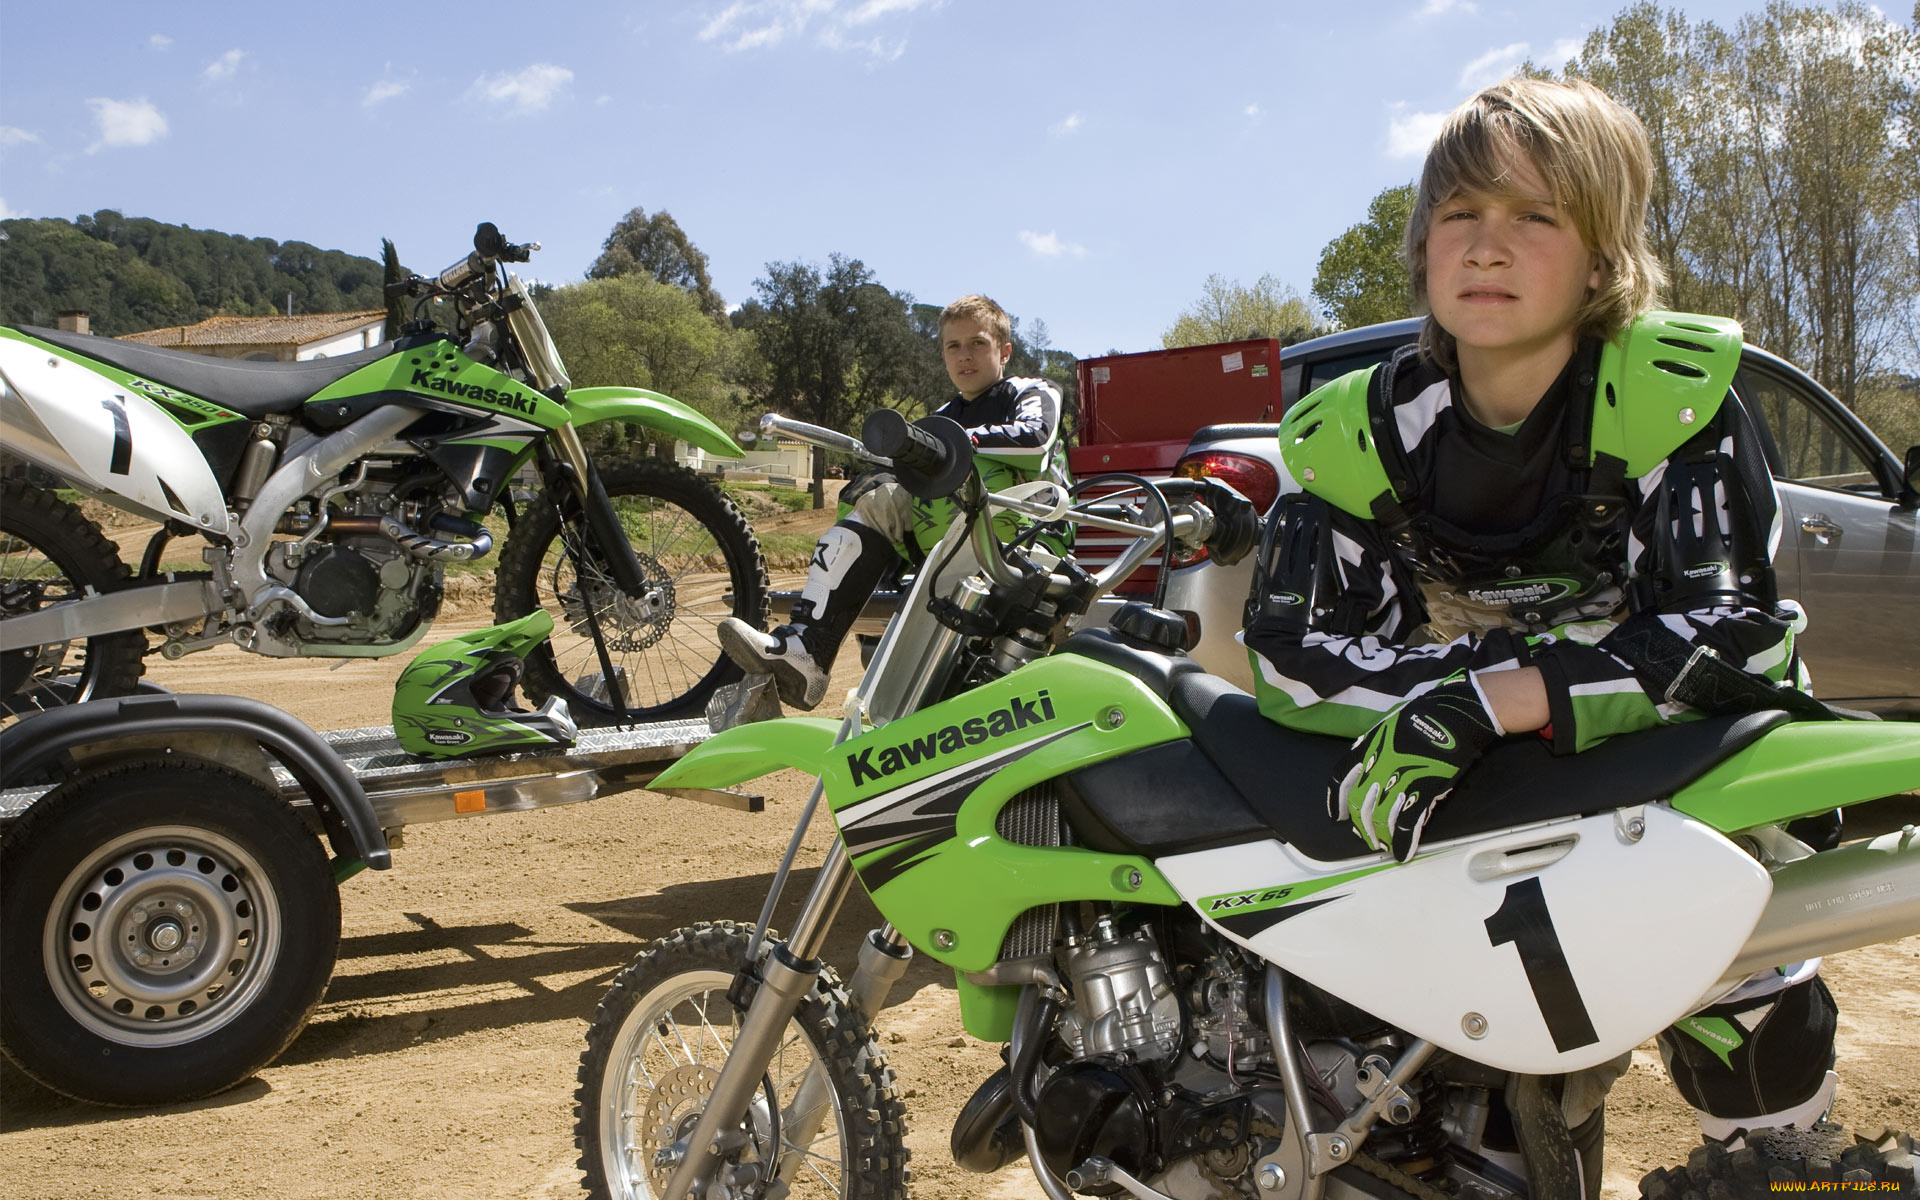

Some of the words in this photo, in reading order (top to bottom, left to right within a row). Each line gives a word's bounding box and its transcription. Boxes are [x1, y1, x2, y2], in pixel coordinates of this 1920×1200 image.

[410, 368, 538, 415] Kawasaki
[101, 394, 133, 476] 1
[1468, 582, 1551, 601] Kawasaki
[1483, 598, 1510, 606] Team
[1511, 595, 1541, 604] Green
[847, 689, 1056, 788] Kawasaki
[1410, 713, 1446, 741] Kawasaki
[1484, 876, 1600, 1054] 1
[1689, 1019, 1738, 1047] Kawasaki
